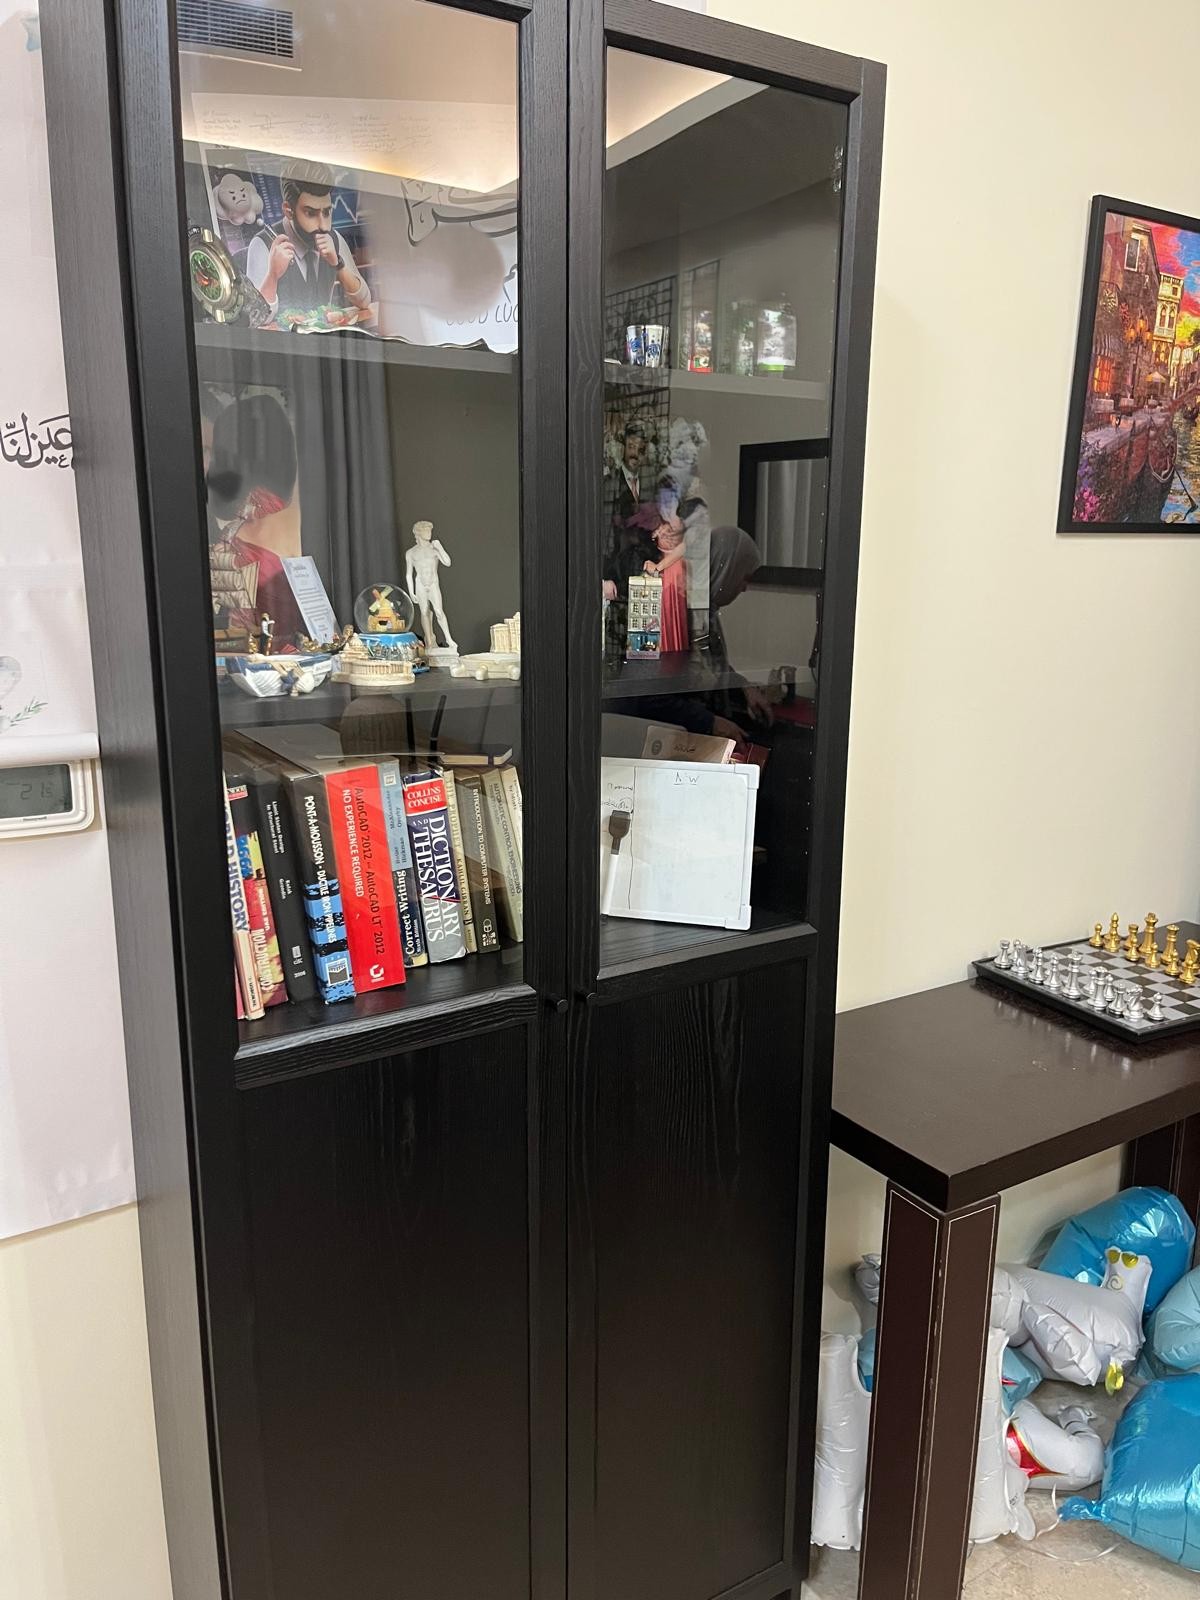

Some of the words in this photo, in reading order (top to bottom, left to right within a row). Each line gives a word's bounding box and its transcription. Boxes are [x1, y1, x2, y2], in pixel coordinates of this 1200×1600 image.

[342, 789, 352, 803] NO
[407, 786, 441, 799] COLLINS
[408, 795, 442, 808] CONCISE
[473, 788, 483, 833] INTRODUCTION
[304, 795, 325, 866] PONT-A-MOUSSON
[344, 804, 359, 855] EXPERIENCE
[361, 835, 373, 860] 2012
[478, 834, 484, 844] TO
[501, 820, 513, 850] CONTROL
[351, 857, 365, 897] REQUIRED
[429, 815, 462, 937] DICTIONARY
[479, 843, 489, 877] COMPUTER
[228, 859, 250, 932] HISTORY
[366, 871, 380, 913] AutoCAD
[397, 869, 409, 912] Writing
[412, 826, 445, 942] THESAURUS
[457, 858, 465, 886] KAHLIL
[461, 886, 471, 916] GIBRAN
[482, 877, 492, 905] SYSTEMS
[374, 931, 385, 955] 2012
[402, 914, 415, 955] Correct
[250, 928, 274, 991] CONSTRUCTION
